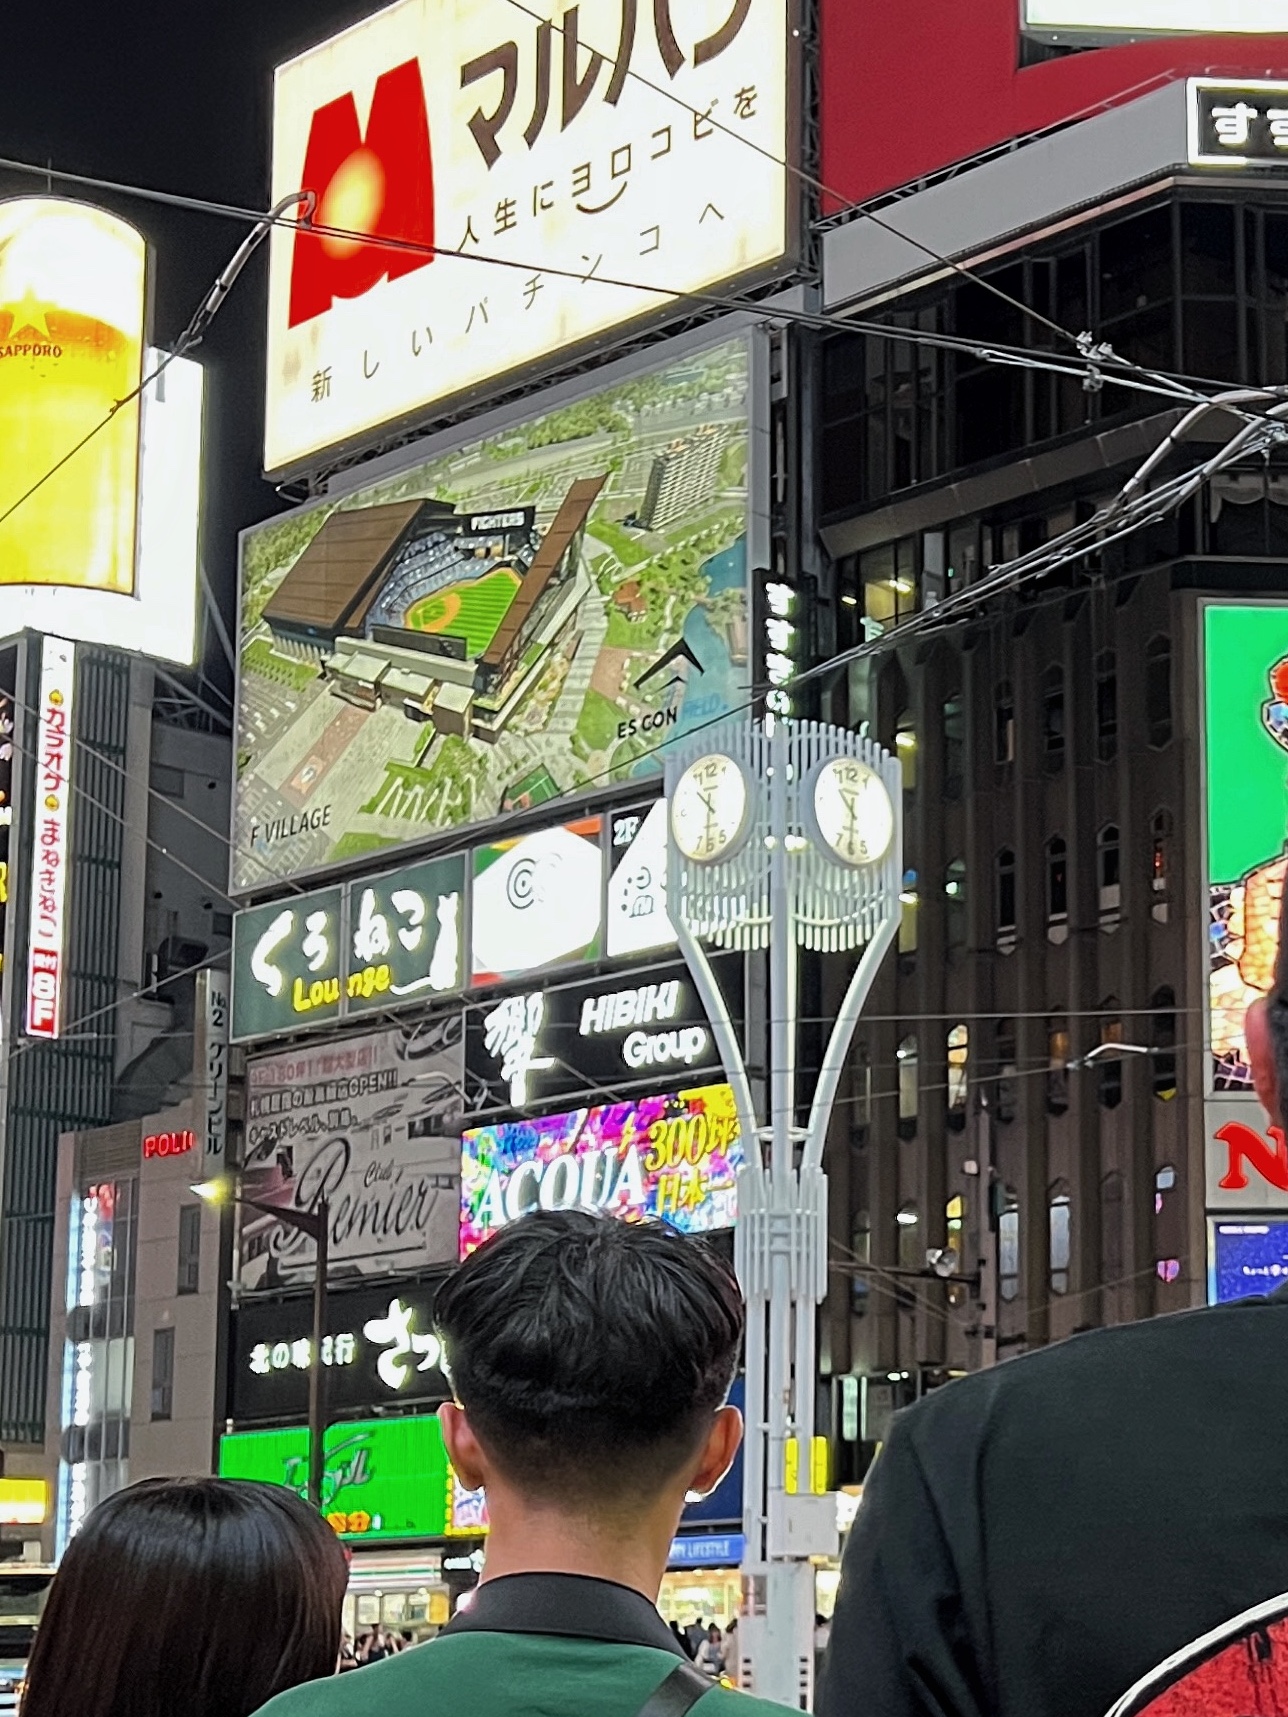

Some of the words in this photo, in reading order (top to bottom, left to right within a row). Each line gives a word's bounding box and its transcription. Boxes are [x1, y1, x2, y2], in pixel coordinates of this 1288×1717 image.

[457, 85, 757, 252] 人生にヨロコビを
[311, 203, 725, 403] 新しいパチンコへ
[44, 707, 65, 791] カラオケ
[251, 825, 260, 848] F
[265, 804, 331, 843] VILLAGE
[38, 817, 61, 938] まねきねこ
[32, 972, 55, 1026] 8F
[293, 965, 390, 1011] Lounge
[579, 980, 680, 1036] HIBIKI
[623, 1026, 706, 1068] Group
